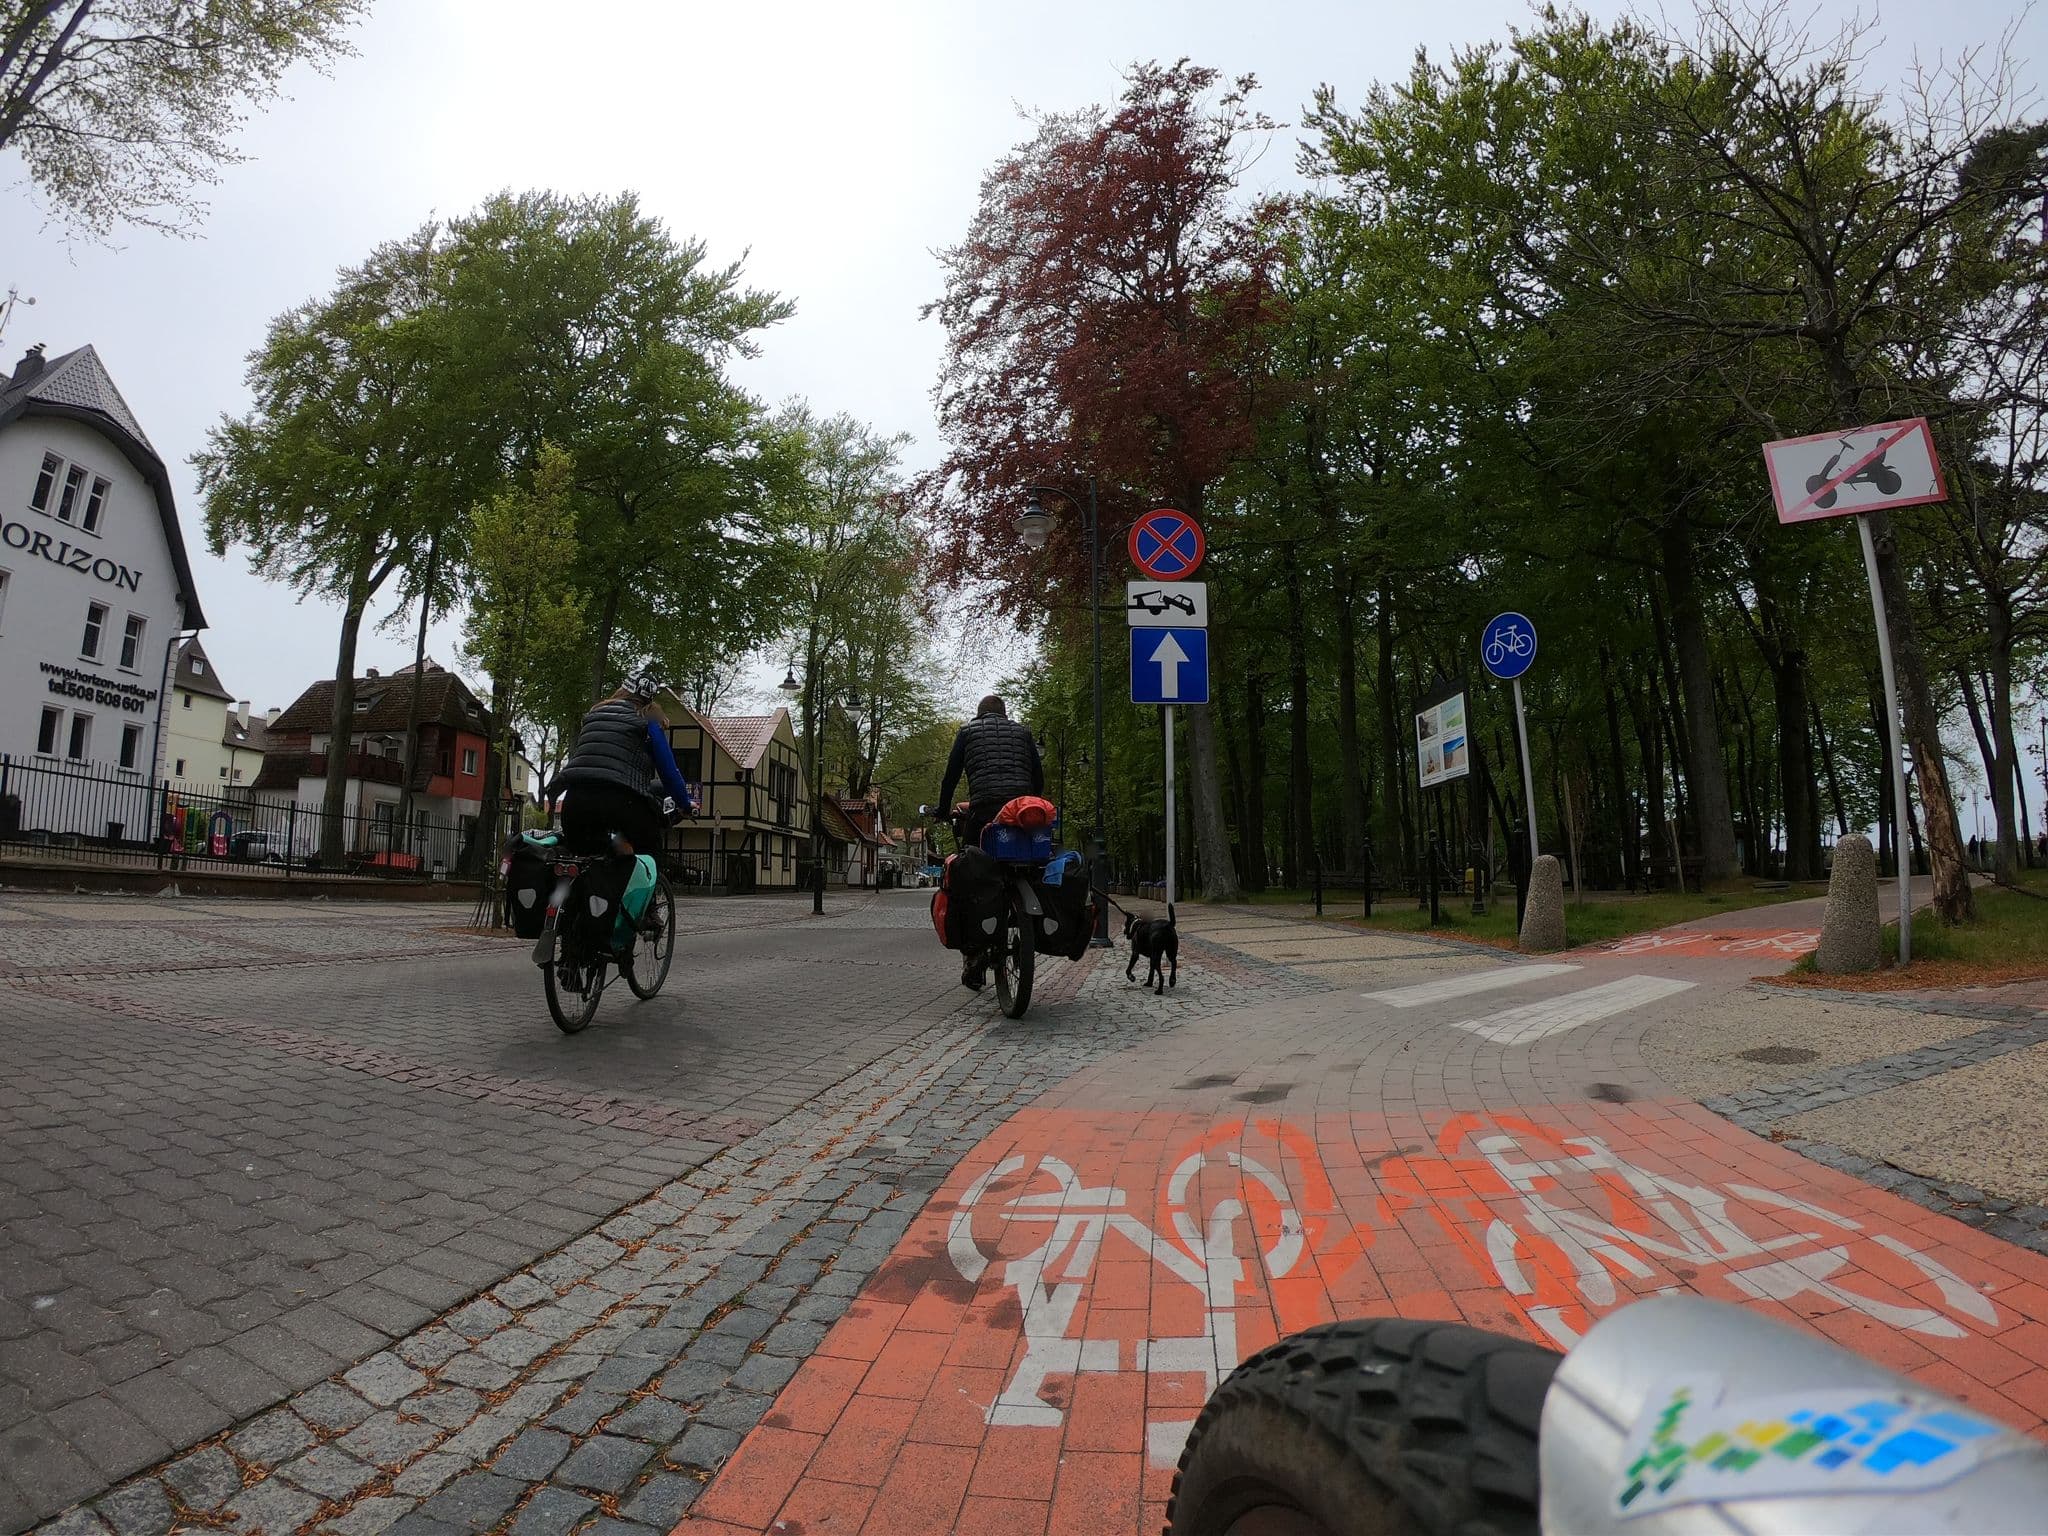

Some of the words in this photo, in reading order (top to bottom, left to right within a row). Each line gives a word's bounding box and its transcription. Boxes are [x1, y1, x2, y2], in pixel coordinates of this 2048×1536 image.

[0, 512, 143, 593] ORIZON
[95, 689, 122, 708] 508
[122, 697, 145, 714] 601
